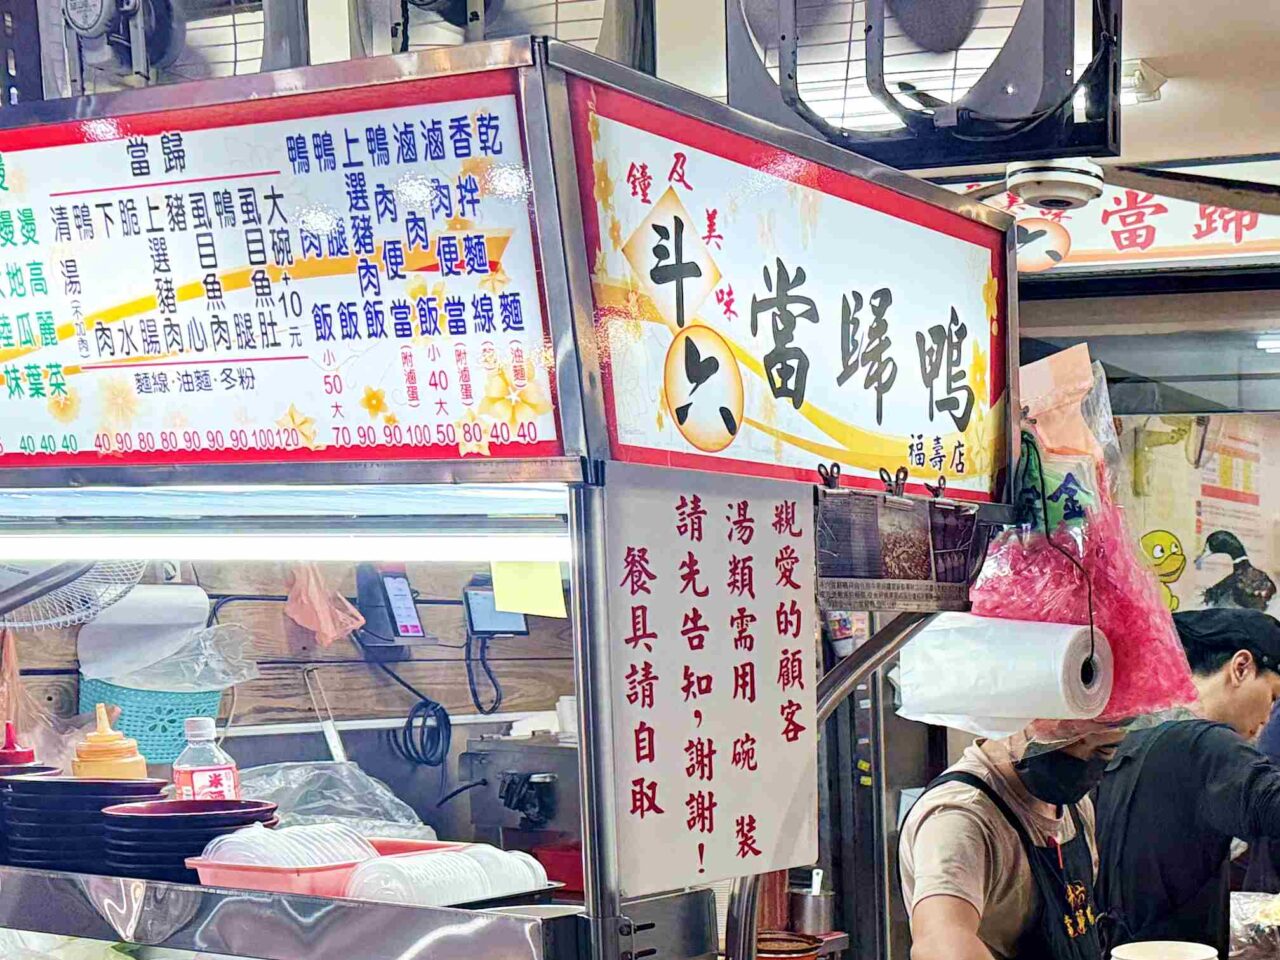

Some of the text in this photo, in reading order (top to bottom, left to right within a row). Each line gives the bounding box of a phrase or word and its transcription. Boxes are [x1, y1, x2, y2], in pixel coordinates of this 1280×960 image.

[127, 133, 186, 177] 當歸
[650, 215, 737, 436] 斗六
[428, 344, 441, 361] 小
[750, 257, 976, 433] 當歸鴨
[323, 349, 336, 367] 小
[323, 374, 343, 395] 50
[429, 370, 448, 390] 40
[331, 402, 345, 418] 大
[434, 398, 449, 416] 大
[20, 434, 78, 453] 40 40 40
[94, 428, 299, 451] 40 90 80 80 90 90 90 100 120
[331, 421, 537, 445] 70 90 90 100 50 80 40 40
[908, 433, 966, 474] 福壽店
[772, 500, 806, 744] 親愛的顧客
[620, 546, 664, 820] 餐具請自取
